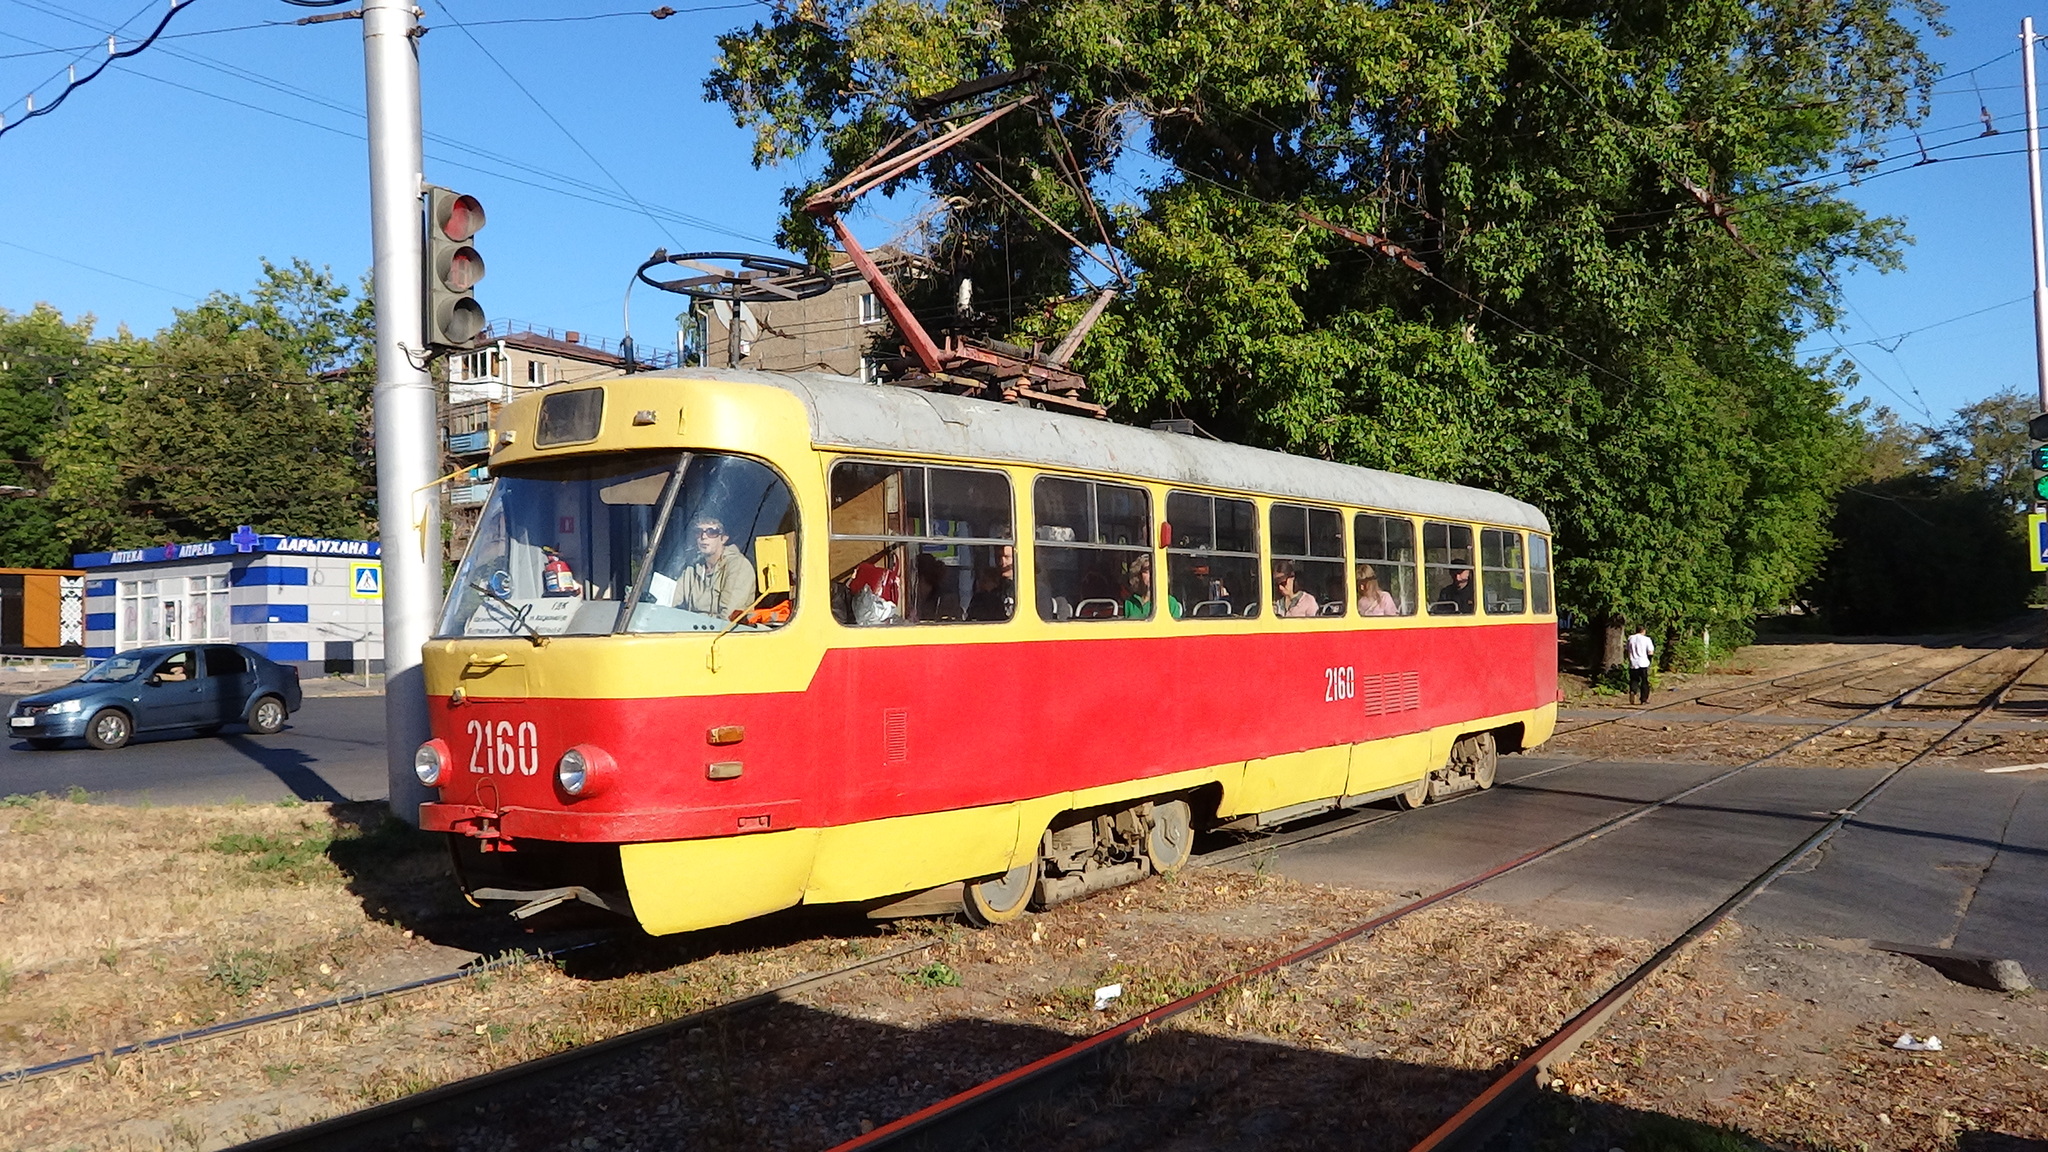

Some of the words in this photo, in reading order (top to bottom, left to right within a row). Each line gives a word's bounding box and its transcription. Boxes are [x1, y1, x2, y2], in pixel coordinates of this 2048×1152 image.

[110, 550, 144, 564] АПТЕКА
[178, 542, 216, 558] АПРЕЛЬ
[277, 538, 369, 555] ДАРЫУХАНА
[1325, 666, 1354, 702] 2160
[467, 719, 538, 776] 2160
